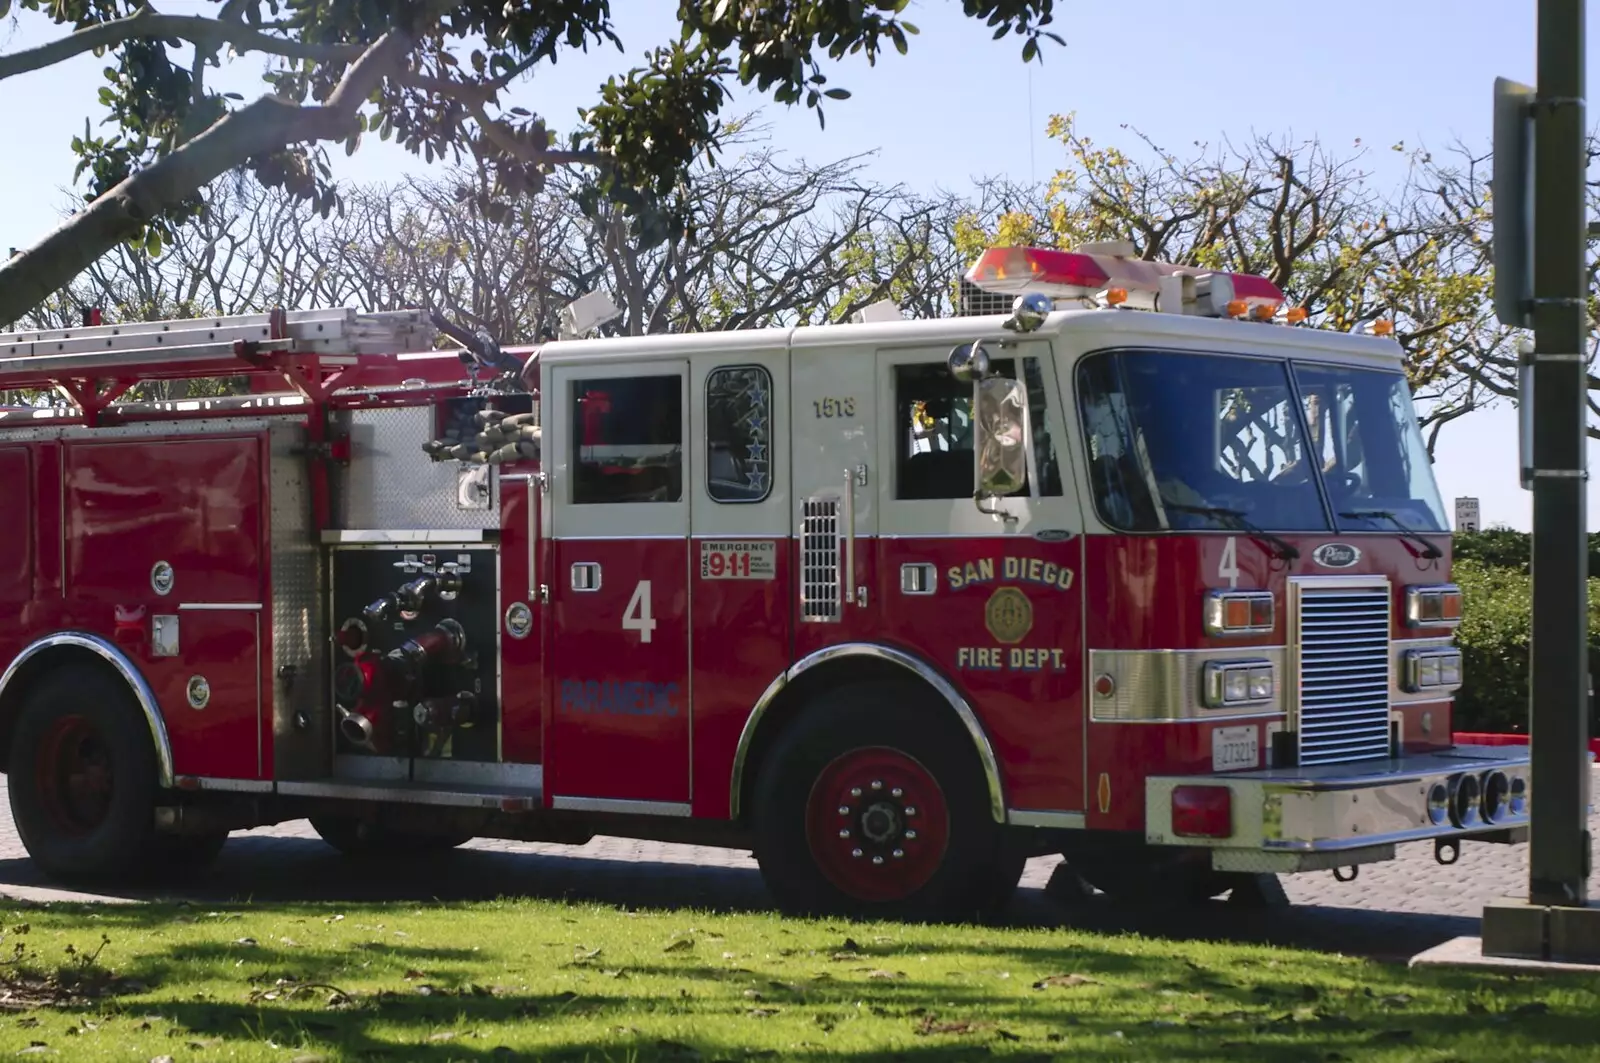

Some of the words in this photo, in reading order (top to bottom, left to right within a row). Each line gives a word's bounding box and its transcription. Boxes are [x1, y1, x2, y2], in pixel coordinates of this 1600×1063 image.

[1456, 501, 1478, 509] SPEED
[1461, 522, 1475, 533] 15
[702, 543, 774, 551] EMERGENCY
[947, 557, 994, 588] SAN
[1004, 556, 1075, 590] DIEGO
[1218, 536, 1239, 591] 4
[622, 580, 657, 643] 4
[958, 647, 1002, 668] FIRE
[1009, 647, 1066, 669] DEPT.
[561, 679, 679, 716] PARAMEDIC
